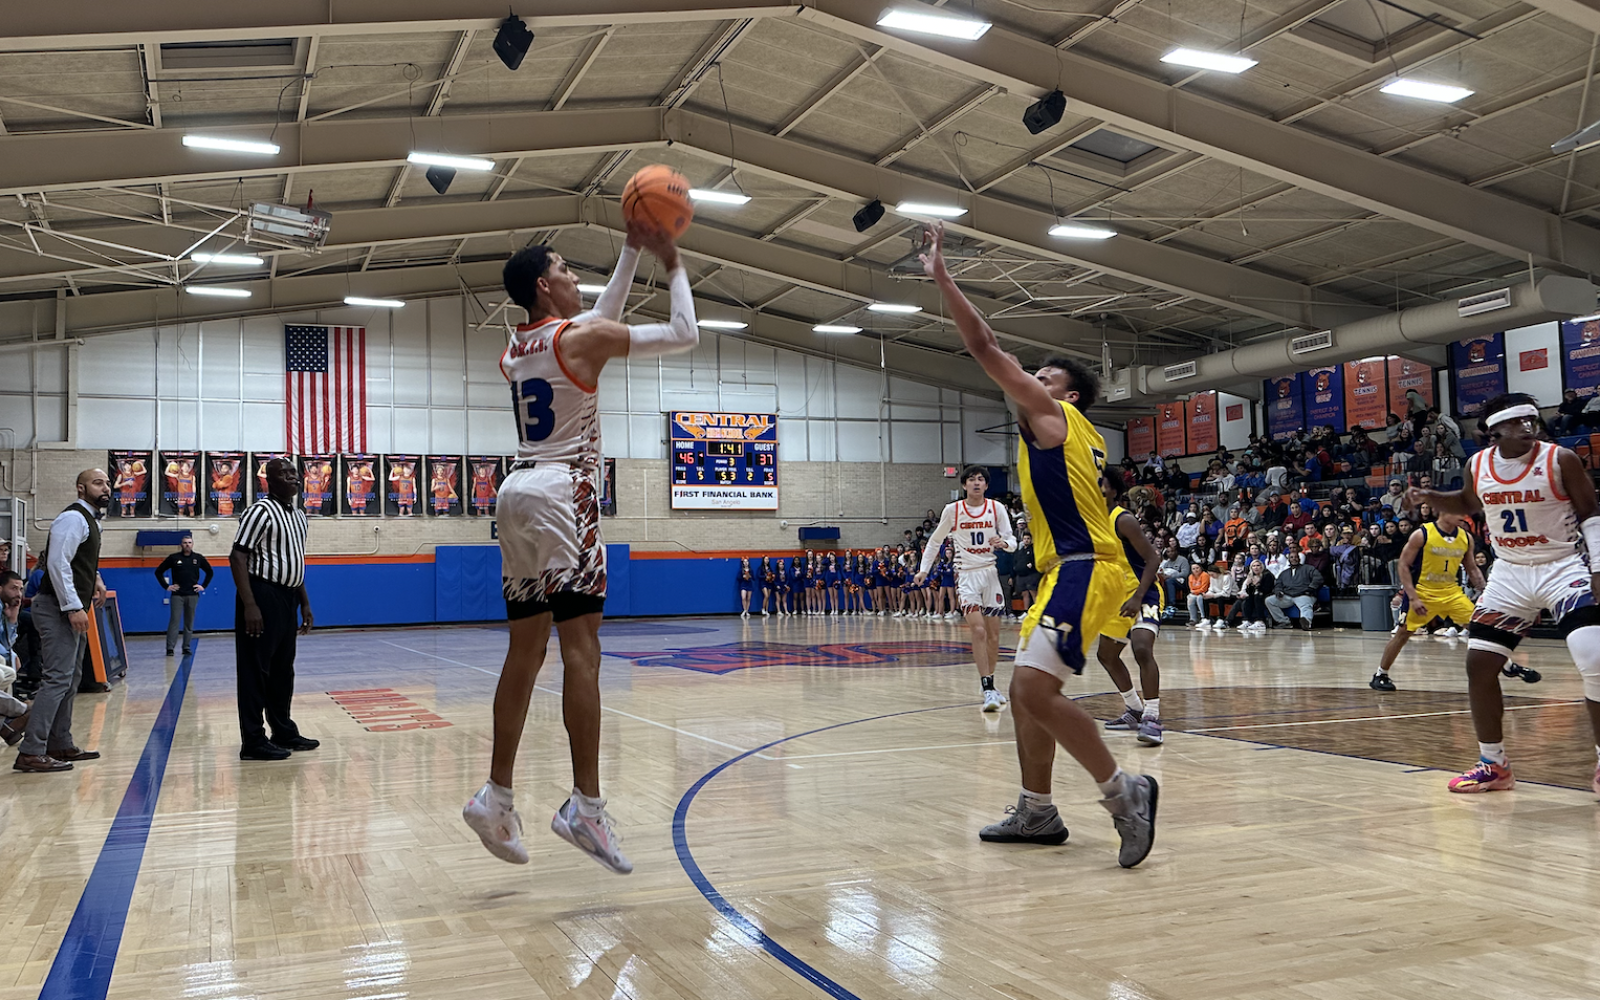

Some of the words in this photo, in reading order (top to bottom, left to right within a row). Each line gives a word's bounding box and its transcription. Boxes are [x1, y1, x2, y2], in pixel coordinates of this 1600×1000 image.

[1459, 364, 1499, 378] SWIMMING
[1398, 377, 1423, 389] TENNIS
[1354, 385, 1378, 396] TENNIS
[511, 377, 556, 442] 13
[675, 413, 770, 427] CENTRAL
[720, 444, 741, 454] 1:41
[679, 452, 694, 464] 46
[760, 454, 773, 465] 37
[1482, 489, 1545, 505] CENTRAL
[960, 520, 993, 530] CENTRAL
[1501, 508, 1528, 533] 21
[970, 532, 985, 546] 10
[1495, 534, 1549, 548] HOOPS
[1443, 560, 1449, 572] 1
